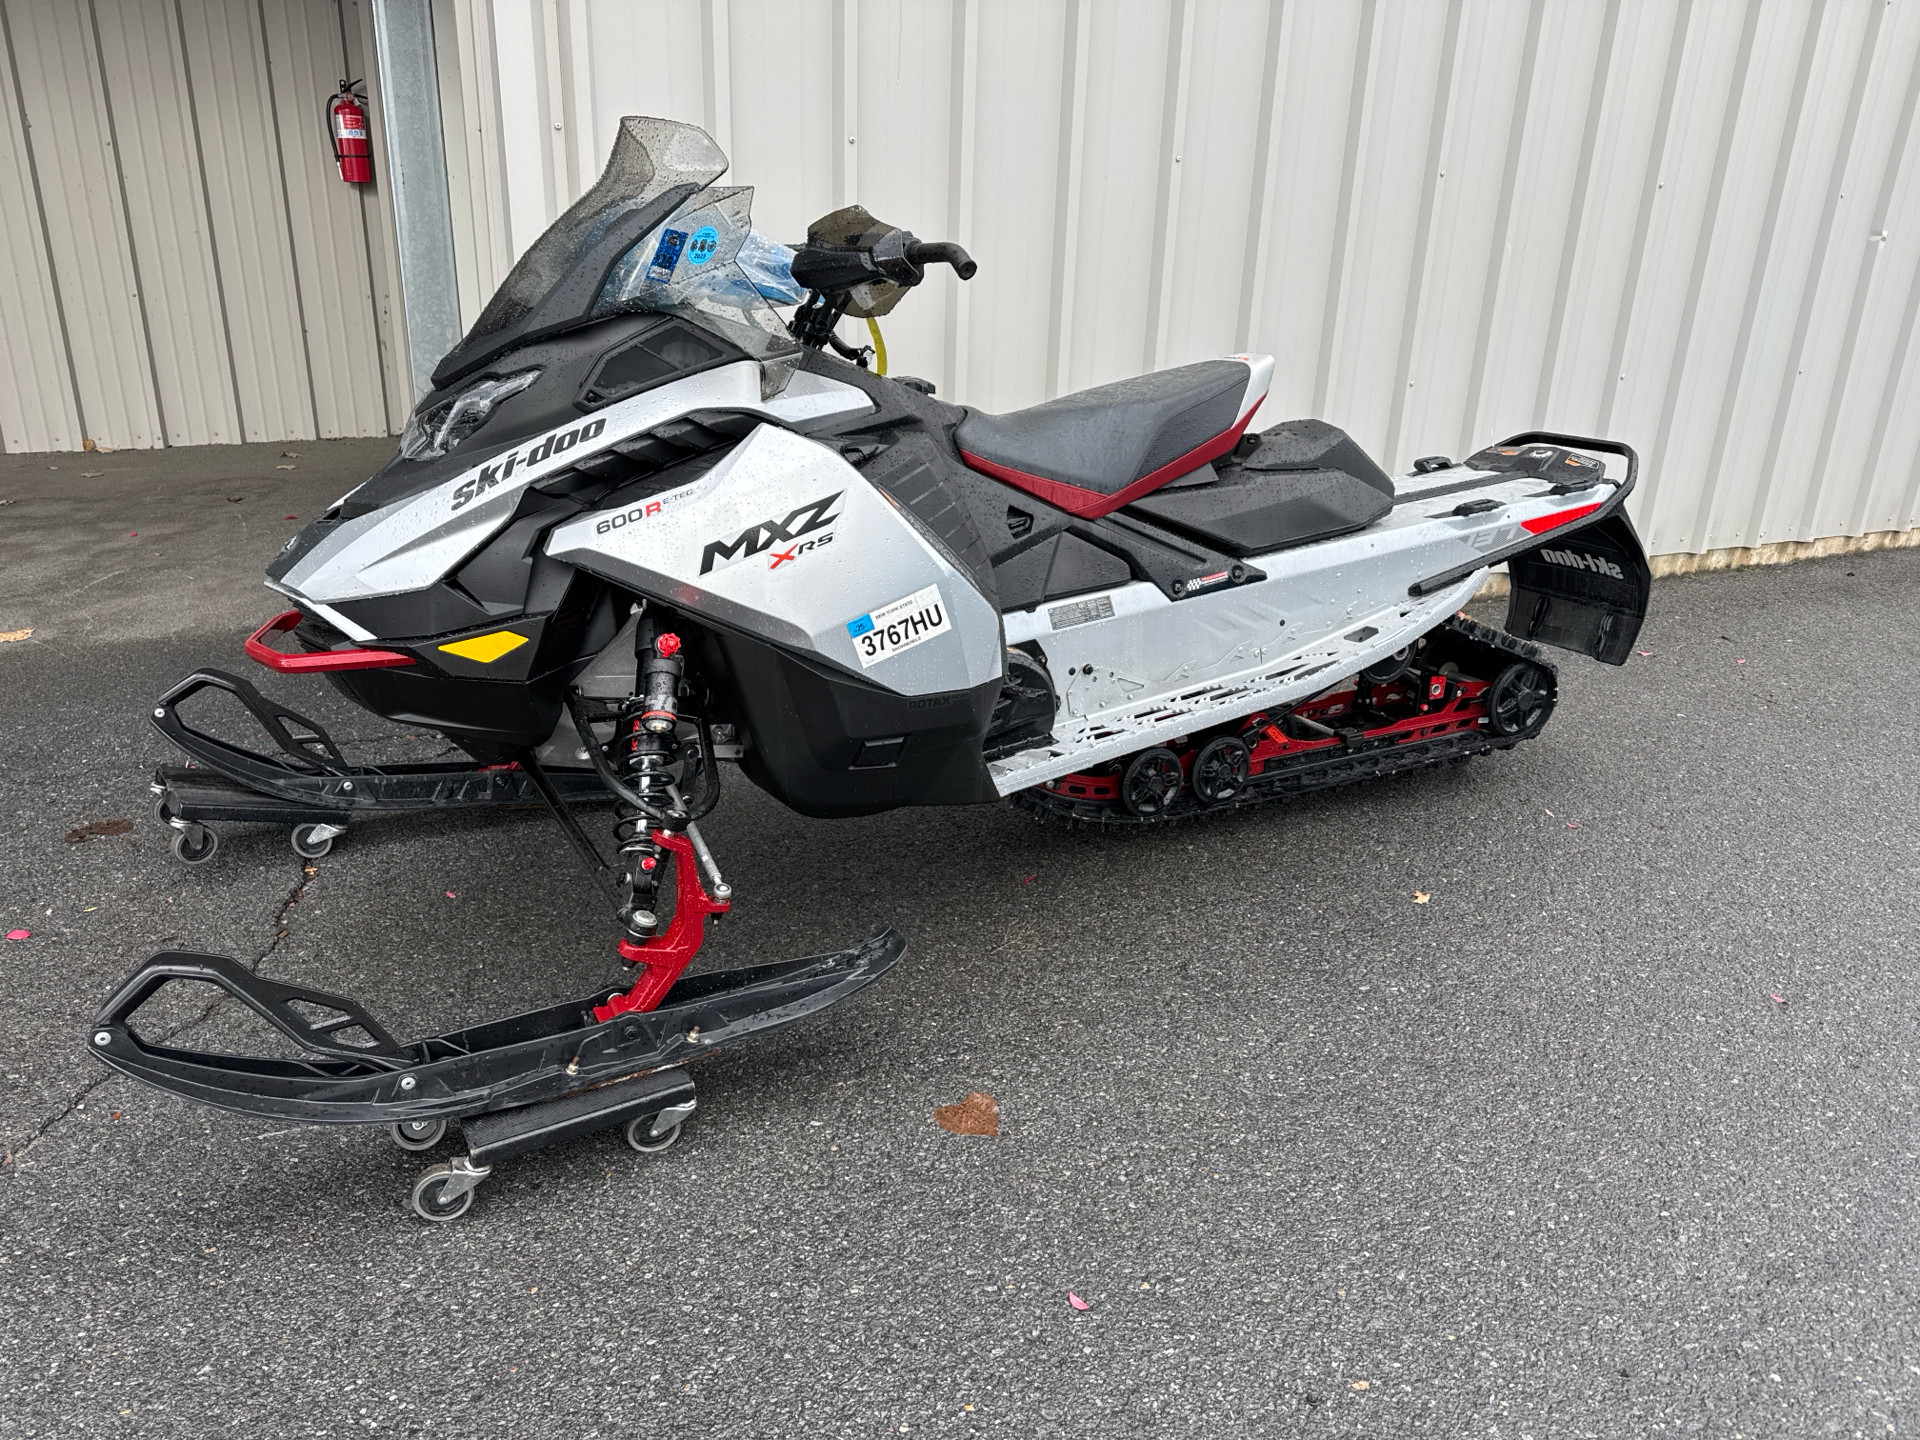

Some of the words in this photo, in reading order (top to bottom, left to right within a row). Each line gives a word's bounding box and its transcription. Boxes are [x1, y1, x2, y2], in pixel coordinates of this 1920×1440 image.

[693, 252, 707, 260] 2025
[451, 418, 607, 511] ski-doo
[699, 489, 845, 577] MXZ
[875, 612, 887, 620] NEW
[887, 606, 899, 615] YORK
[899, 600, 914, 610] STATE
[861, 603, 943, 656] 3767HU
[908, 696, 951, 710] ROTAX
